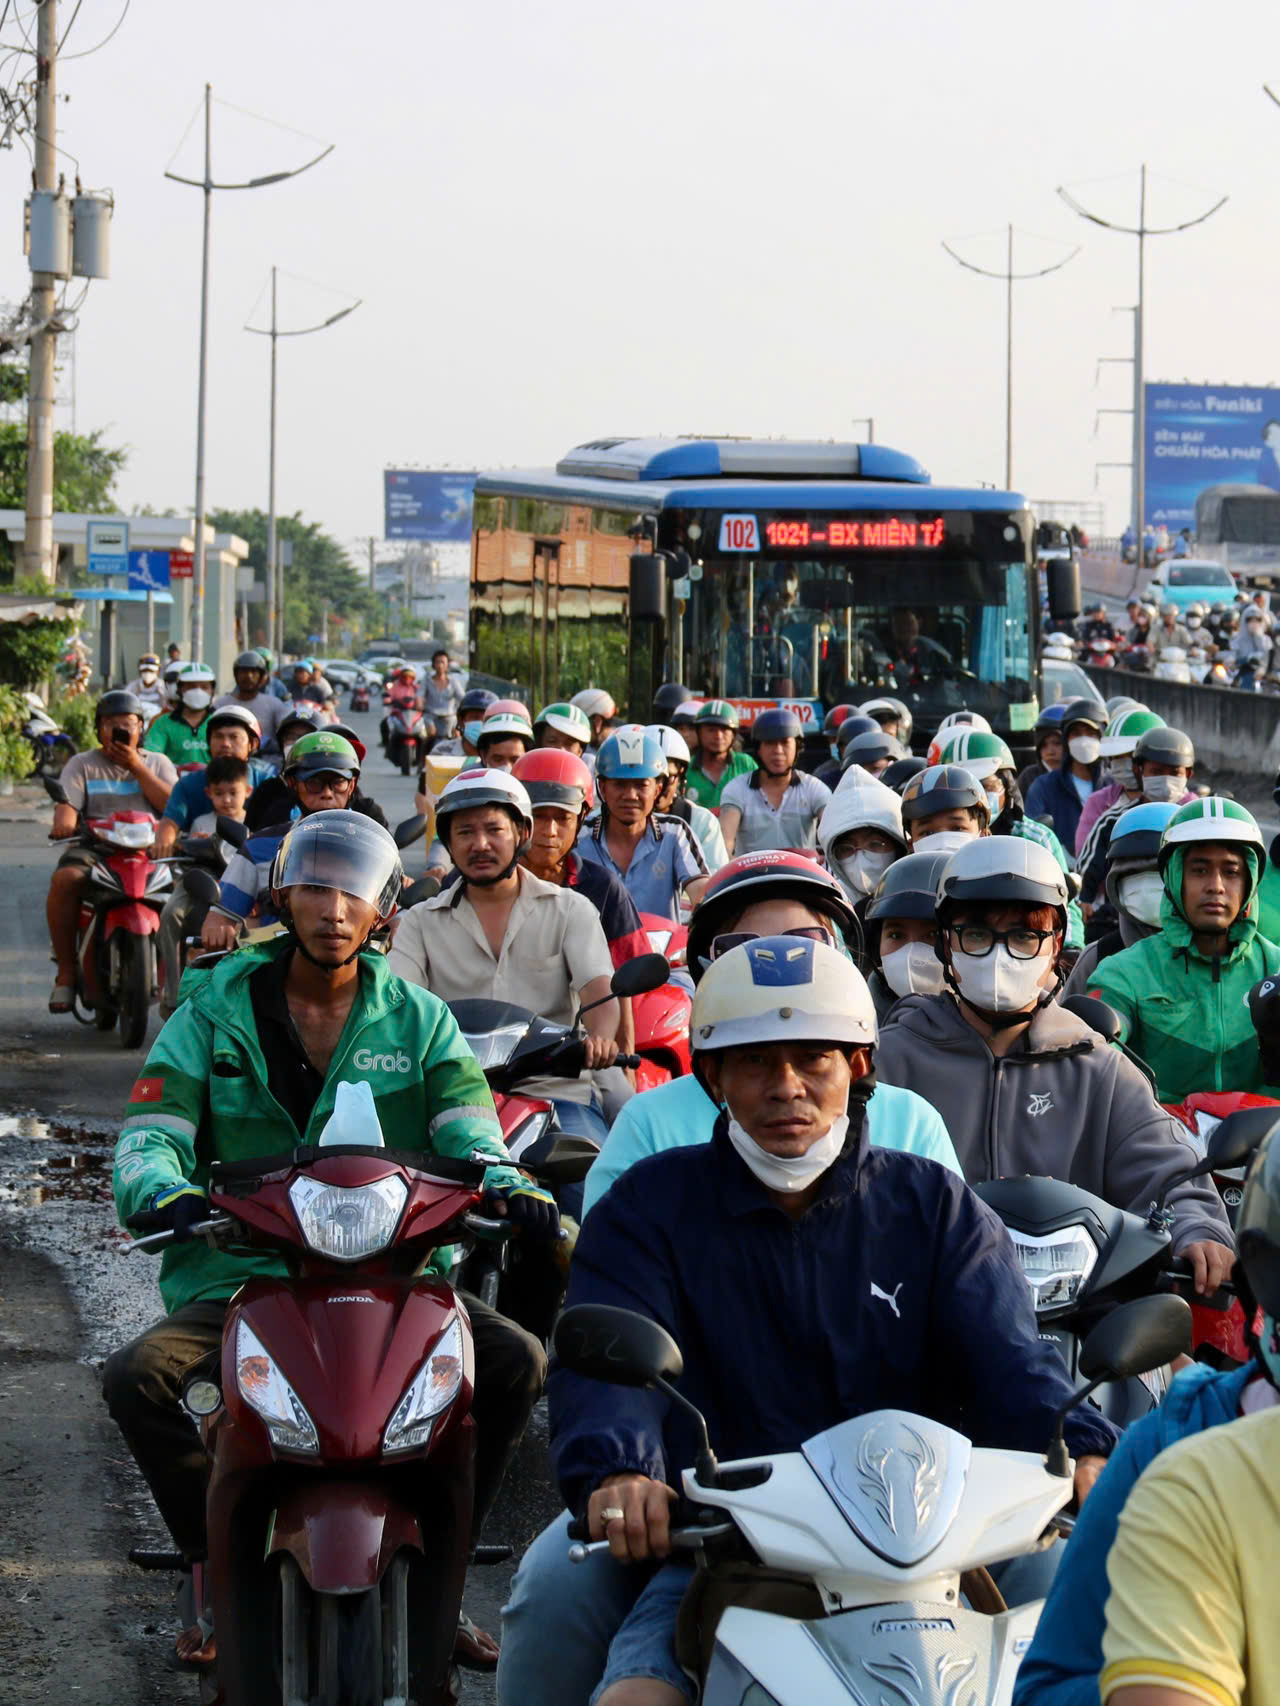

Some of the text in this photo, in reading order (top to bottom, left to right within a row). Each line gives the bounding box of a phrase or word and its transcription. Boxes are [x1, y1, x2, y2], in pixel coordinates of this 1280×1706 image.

[724, 519, 755, 549] 102
[829, 522, 859, 546] BX
[353, 1049, 412, 1073] Grab
[328, 1296, 376, 1304] HONDA
